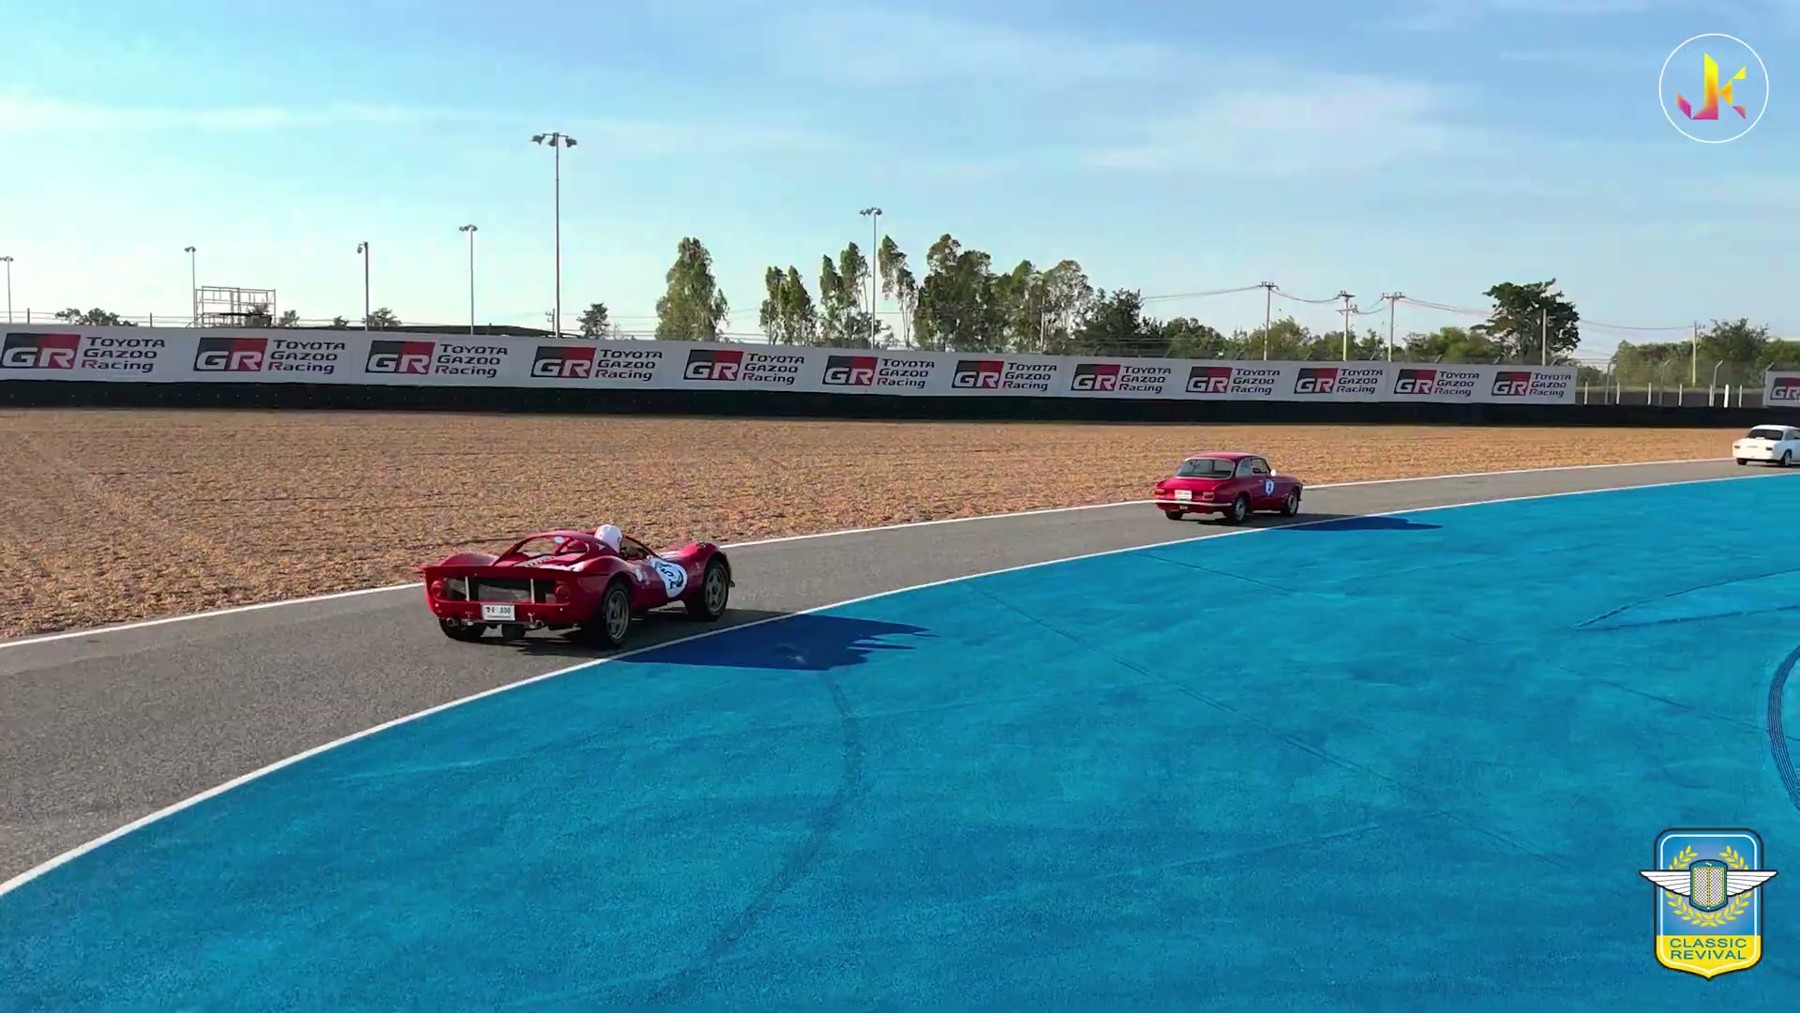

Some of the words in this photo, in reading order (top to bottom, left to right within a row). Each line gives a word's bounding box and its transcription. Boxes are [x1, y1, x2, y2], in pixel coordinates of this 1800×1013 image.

[85, 336, 165, 348] TOYOTA
[273, 339, 346, 351] TOYOTA
[83, 349, 157, 359] GAZOO
[440, 344, 508, 355] TOYOTA
[600, 349, 662, 360] TOYOTA
[1, 348, 77, 368] GR
[196, 351, 264, 370] GR
[270, 351, 338, 361] GAZOO
[438, 355, 500, 365] GAZOO
[747, 353, 804, 364] TOYOTA
[81, 359, 154, 373] Racing
[268, 361, 334, 375] Racing
[366, 354, 431, 373] GR
[533, 359, 591, 378] GR
[597, 359, 656, 369] GAZOO
[744, 363, 798, 373] GAZOO
[882, 358, 935, 369] TOYOTA
[1007, 362, 1057, 372] TOYOTA
[435, 365, 497, 378] Racing
[595, 369, 653, 381] Racing
[686, 362, 738, 380] GR
[824, 367, 873, 384] GR
[879, 368, 929, 378] GAZOO
[1005, 372, 1051, 380] GAZOO
[1124, 366, 1171, 375] TOYOTA
[1235, 368, 1280, 376] TOYOTA
[1340, 368, 1383, 376] TOYOTA
[1439, 371, 1480, 379] TOYOTA
[1534, 372, 1572, 380] TOYOTA
[742, 372, 795, 386] Racing
[876, 377, 926, 389] Racing
[953, 372, 1000, 388] GR
[1073, 375, 1117, 391] GR
[1121, 375, 1166, 383] GAZOO
[1233, 377, 1274, 385] GAZOO
[1002, 380, 1049, 392] Racing
[1119, 383, 1162, 394] Racing
[1187, 377, 1228, 393] GR
[1231, 385, 1272, 395] Racing
[1295, 378, 1334, 393] GR
[1337, 385, 1376, 394] Racing
[1395, 379, 1434, 394] GR
[1493, 381, 1528, 396] GR
[1434, 387, 1471, 397] Racing
[1529, 388, 1564, 397] Racing
